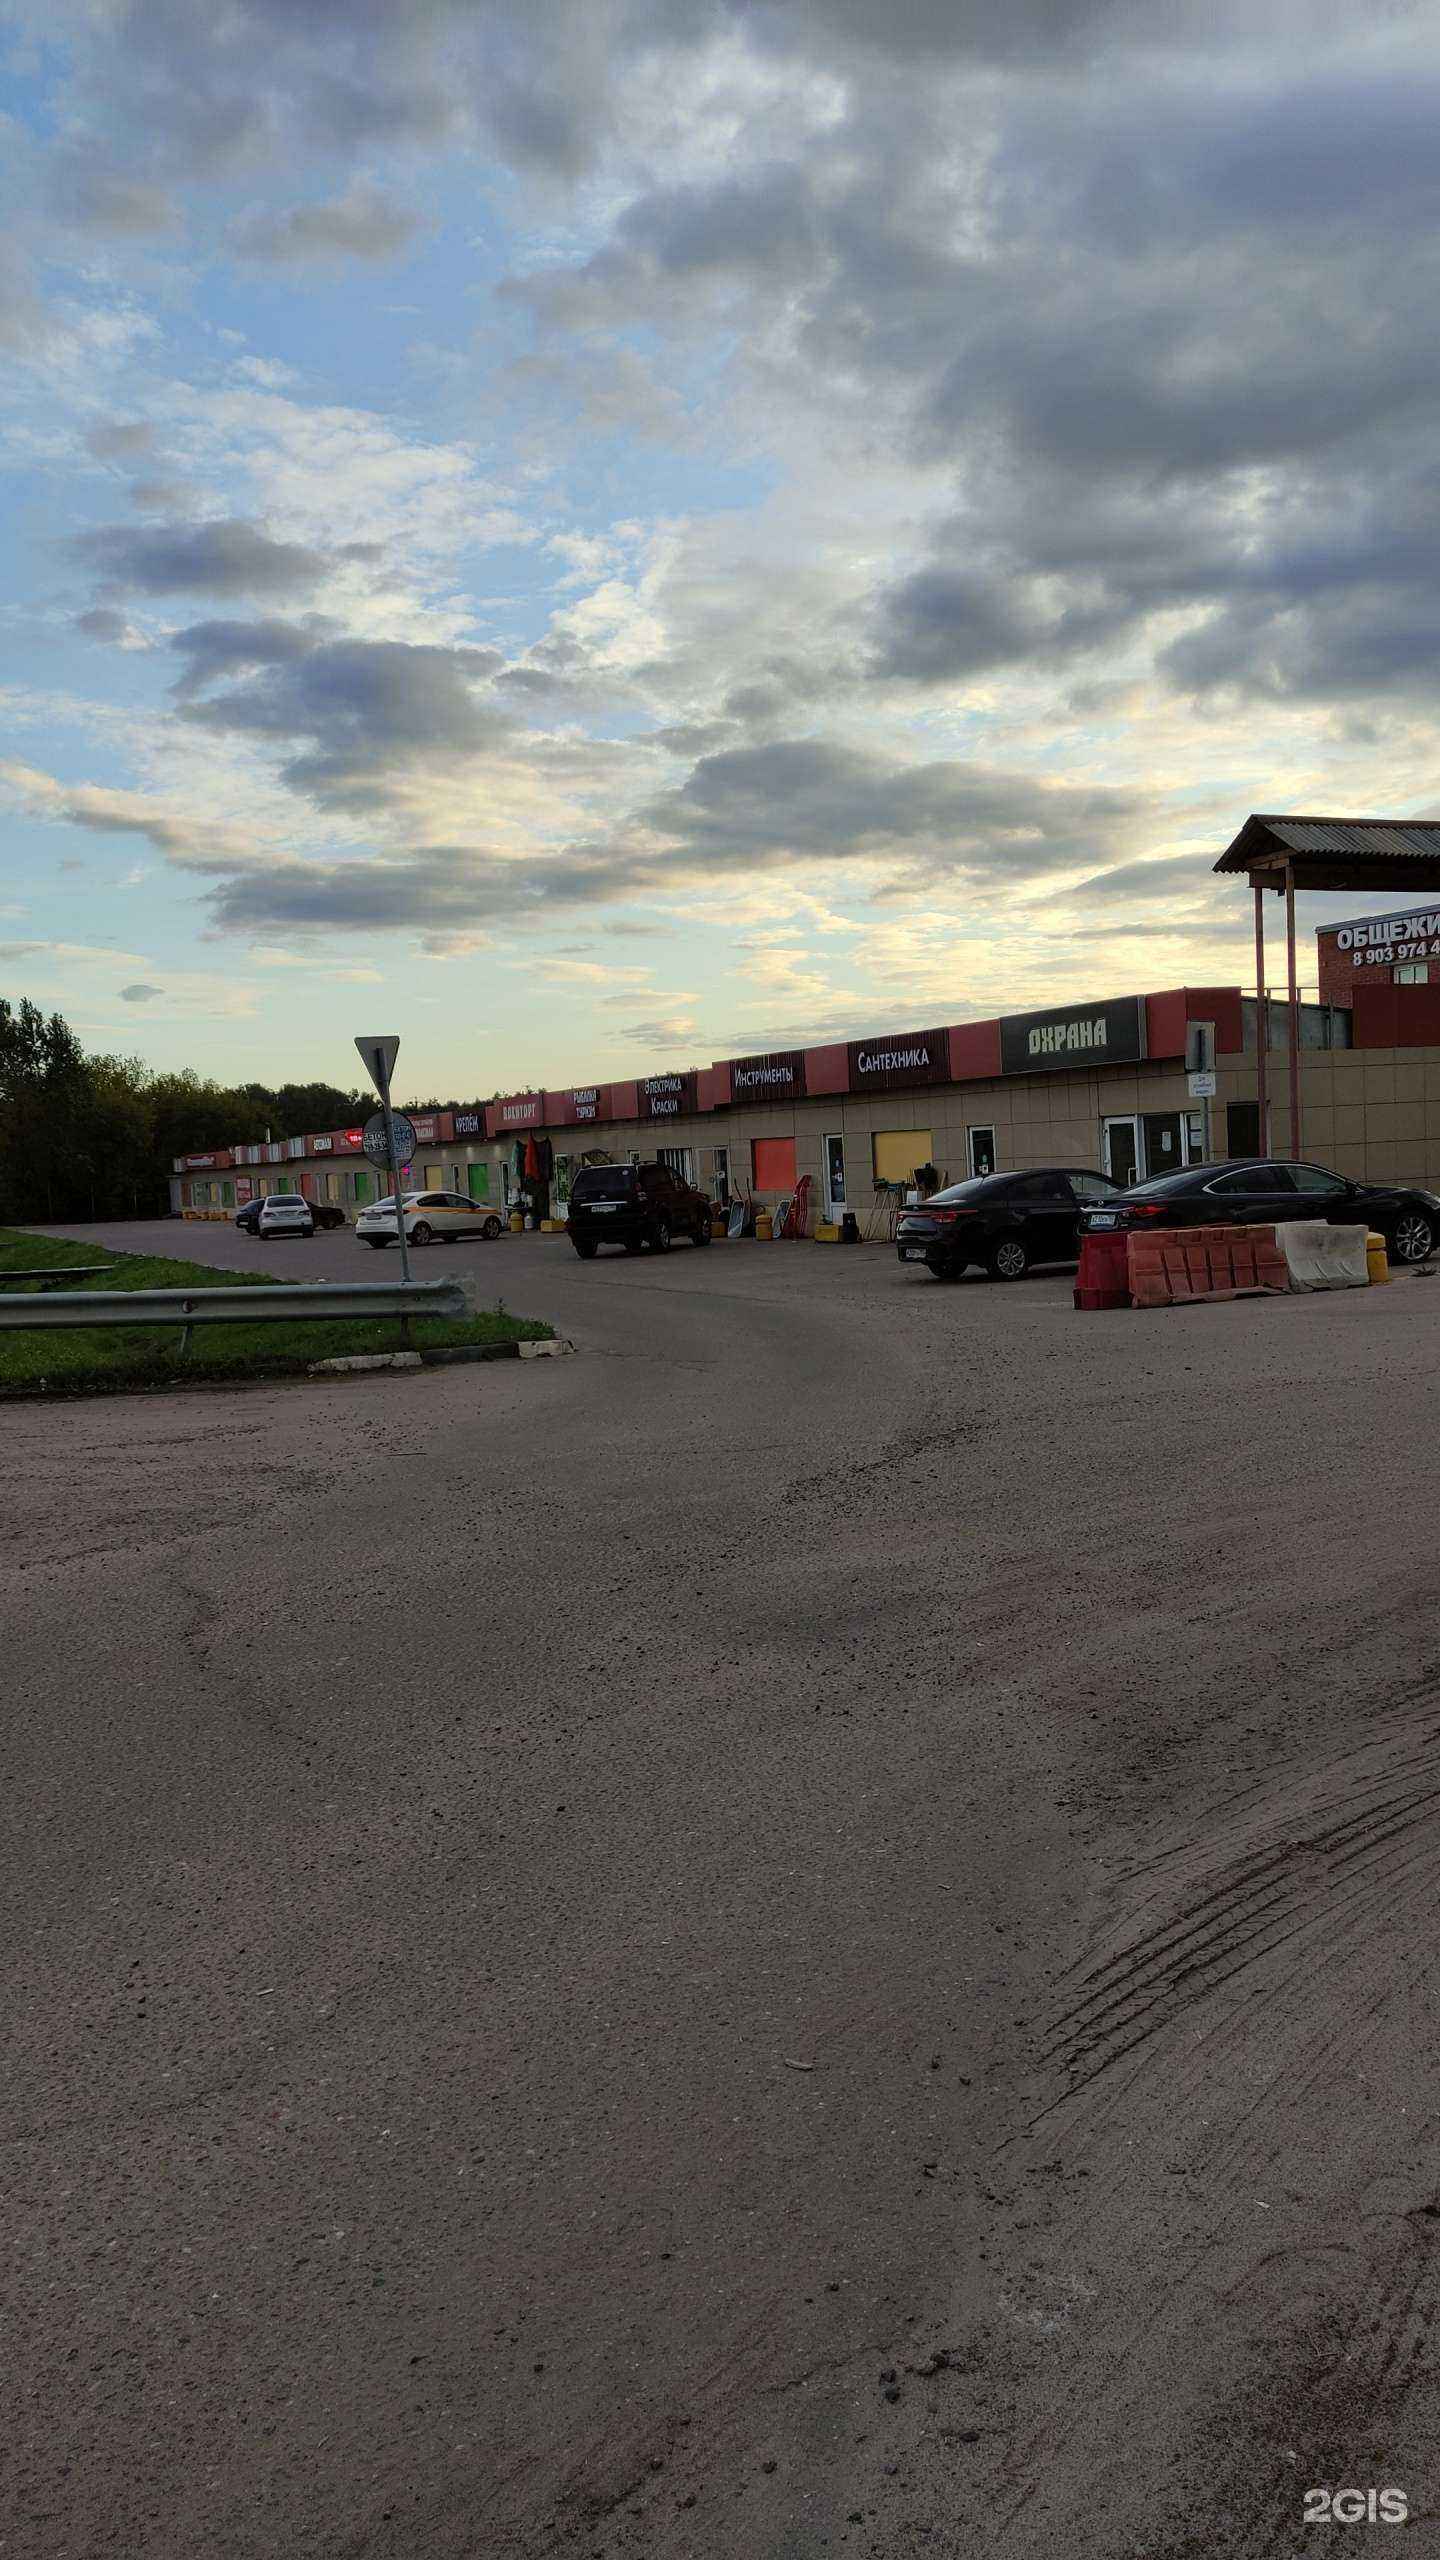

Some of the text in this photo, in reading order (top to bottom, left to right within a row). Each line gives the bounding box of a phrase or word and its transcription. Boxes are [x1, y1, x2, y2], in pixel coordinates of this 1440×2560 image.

[1353, 951, 1362, 966] 8
[1366, 947, 1393, 964] 903
[1397, 941, 1427, 959] 974
[1028, 1018, 1107, 1054] ОХРАНА
